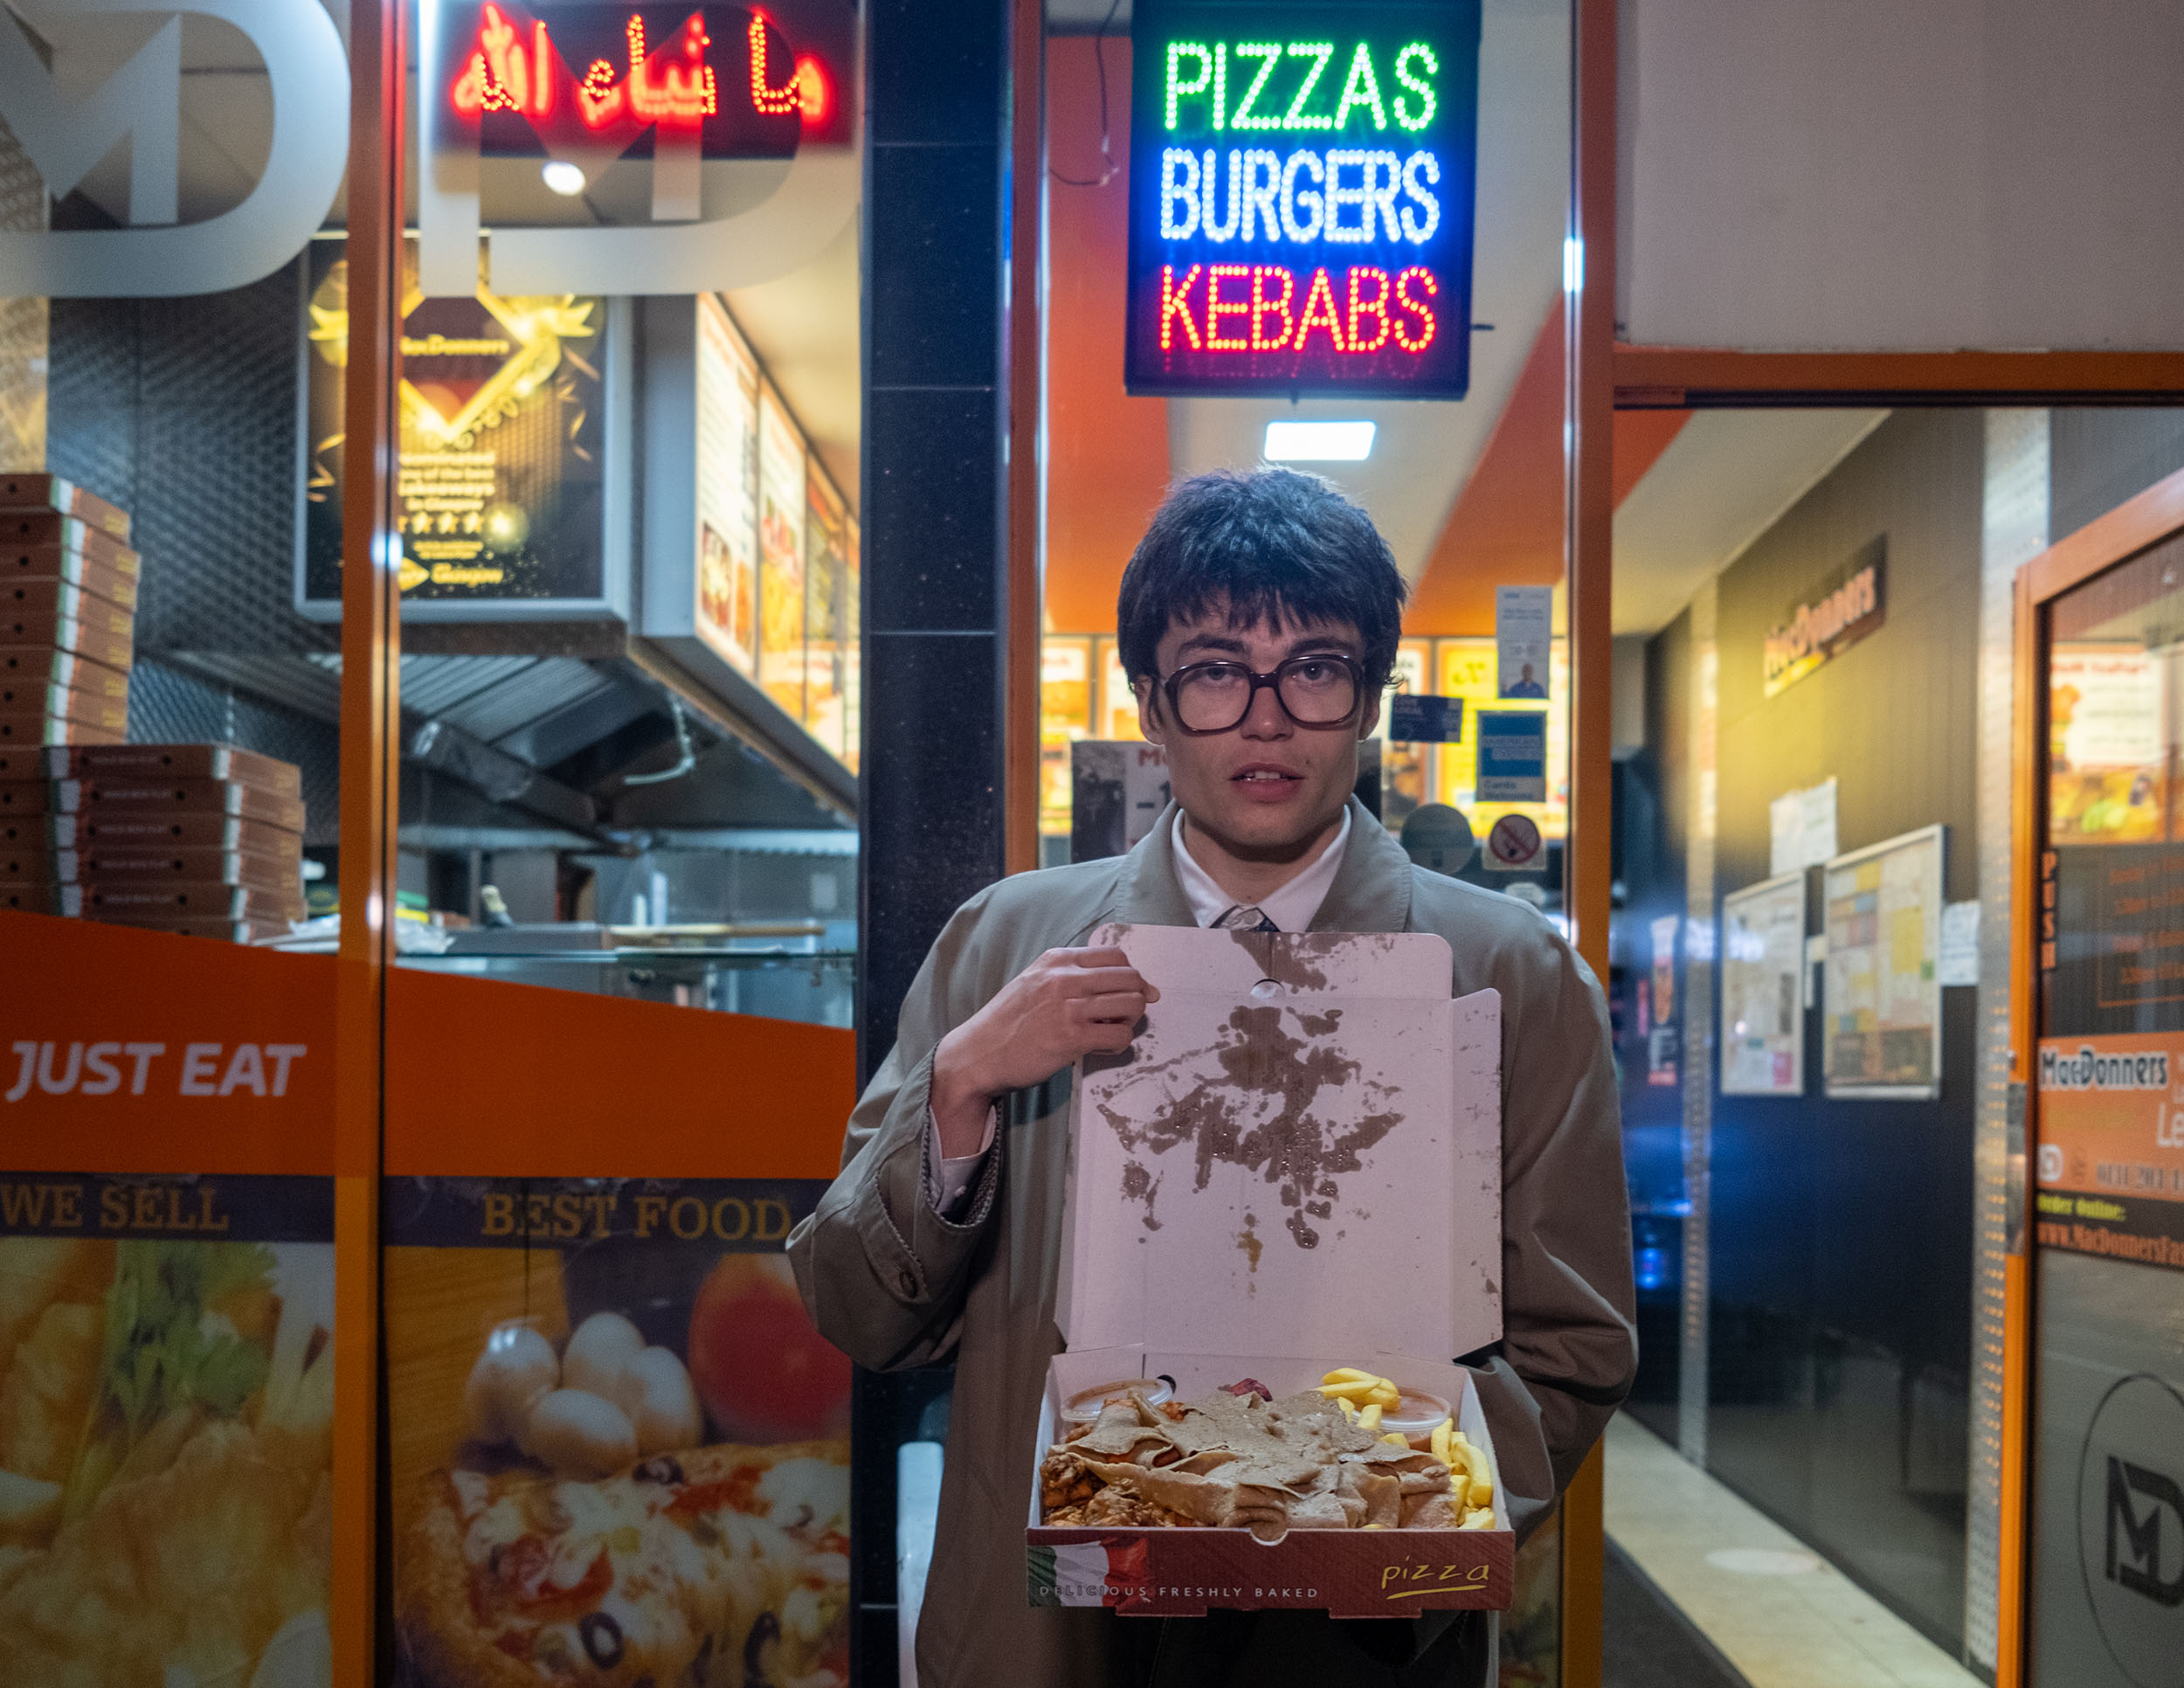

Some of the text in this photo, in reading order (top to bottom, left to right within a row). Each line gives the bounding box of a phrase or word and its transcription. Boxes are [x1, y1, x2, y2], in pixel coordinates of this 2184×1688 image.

[1165, 41, 1440, 132] PIZZAS
[1160, 148, 1441, 244] BURGERS
[1159, 264, 1438, 353] KEBABS
[6, 1041, 308, 1103] JUST EAT
[0, 1184, 229, 1230] WE SELL
[481, 1193, 791, 1241] BEST FOOD
[1040, 1585, 1317, 1598] DELICIOUS FRESHLY BAKED
[1381, 1554, 1489, 1590] pizza
